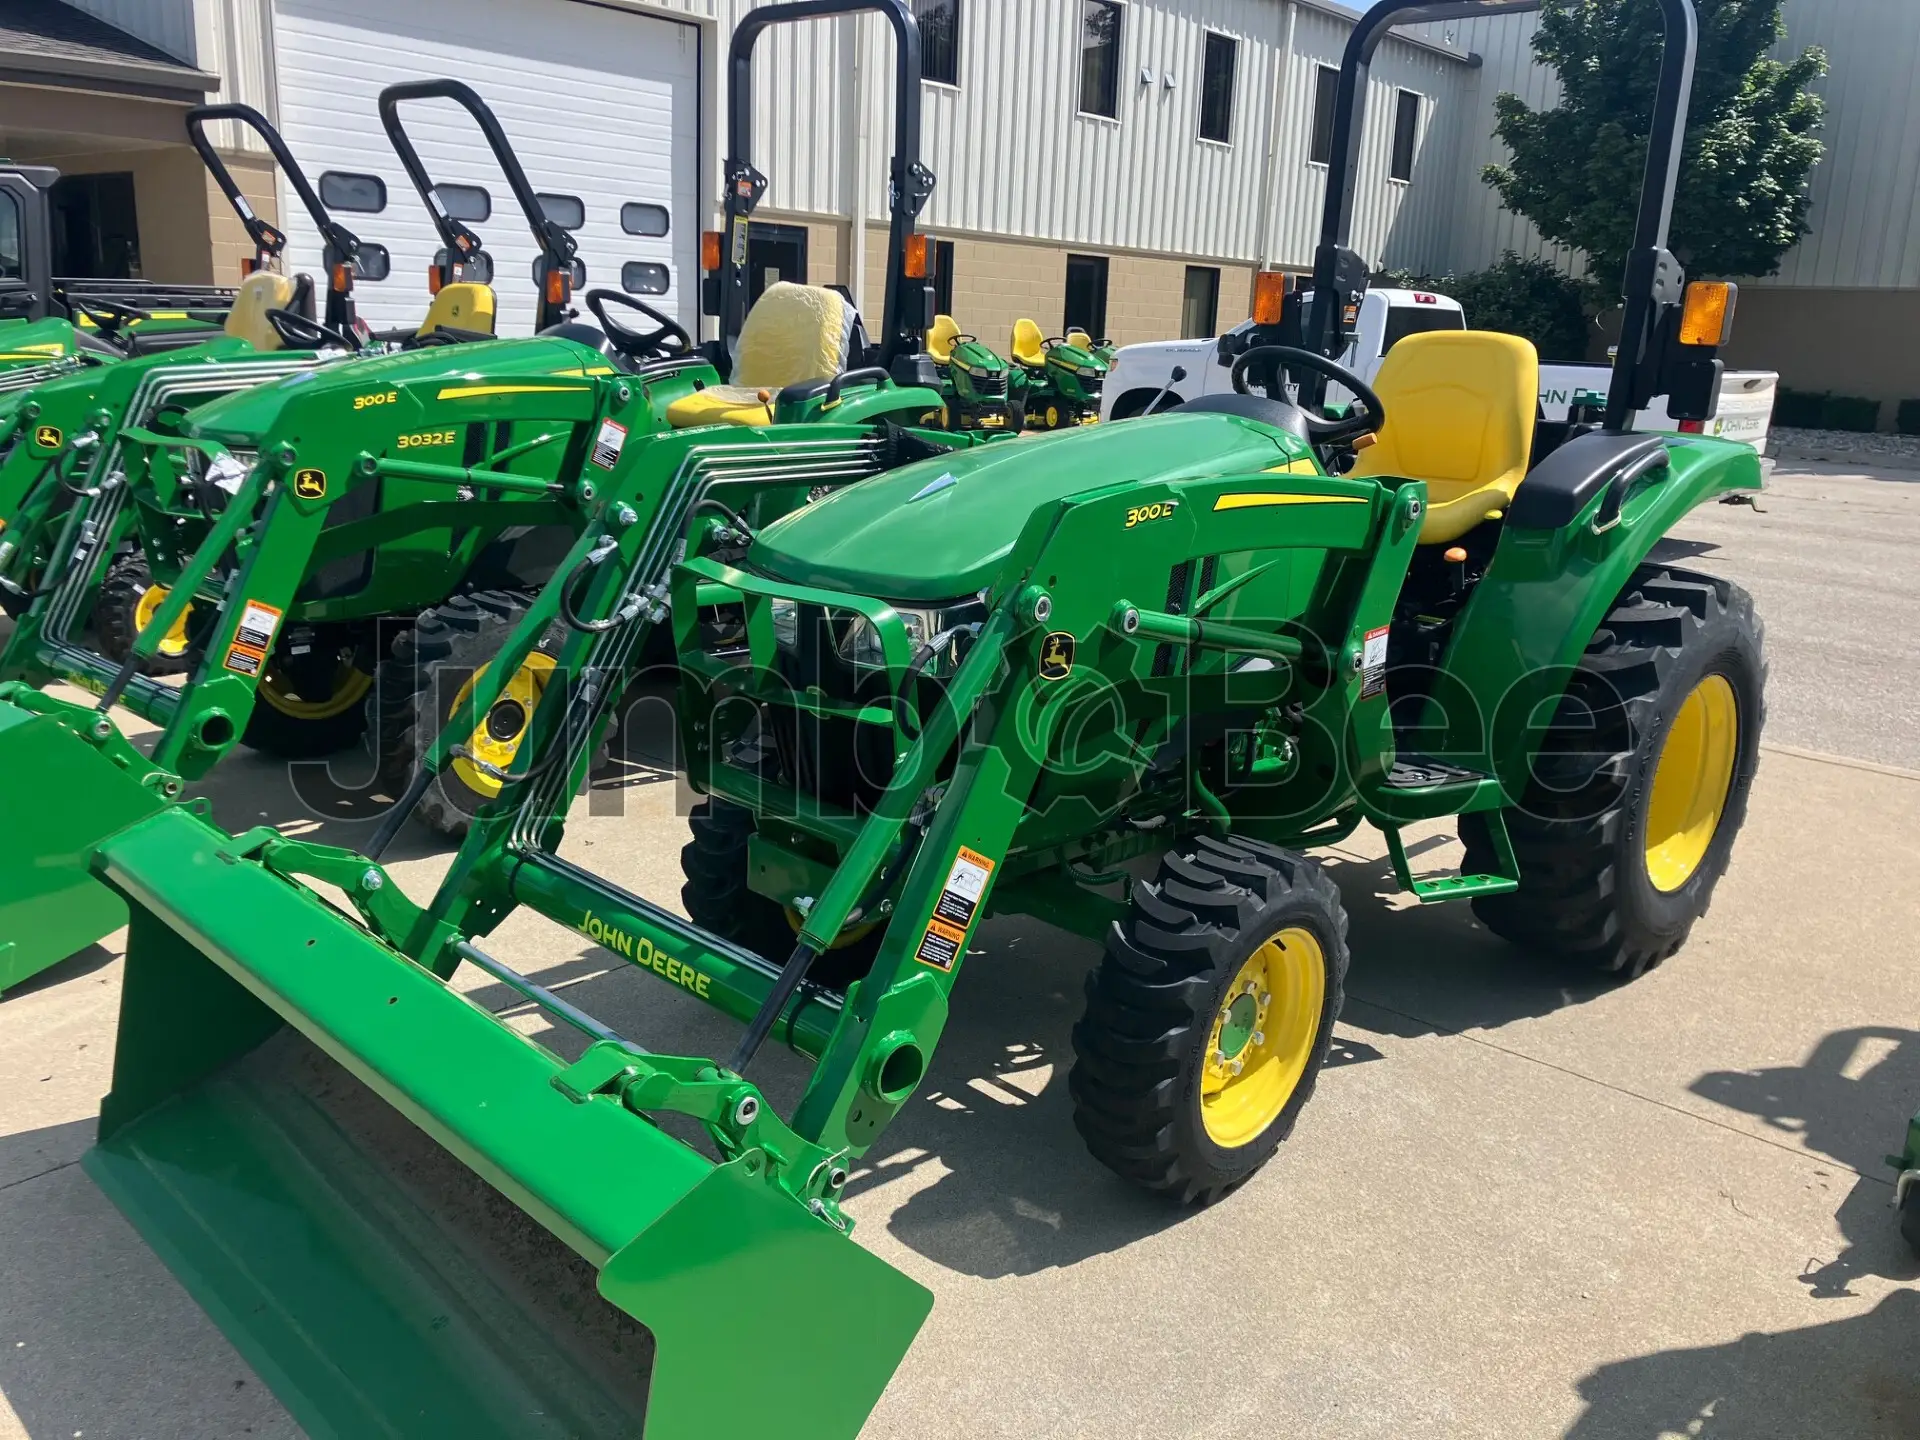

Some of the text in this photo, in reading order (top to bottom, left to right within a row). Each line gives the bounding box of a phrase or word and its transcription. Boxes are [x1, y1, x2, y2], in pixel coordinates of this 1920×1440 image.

[577, 909, 711, 1000] JOHN DEERE
[937, 925, 961, 941] WARNING
